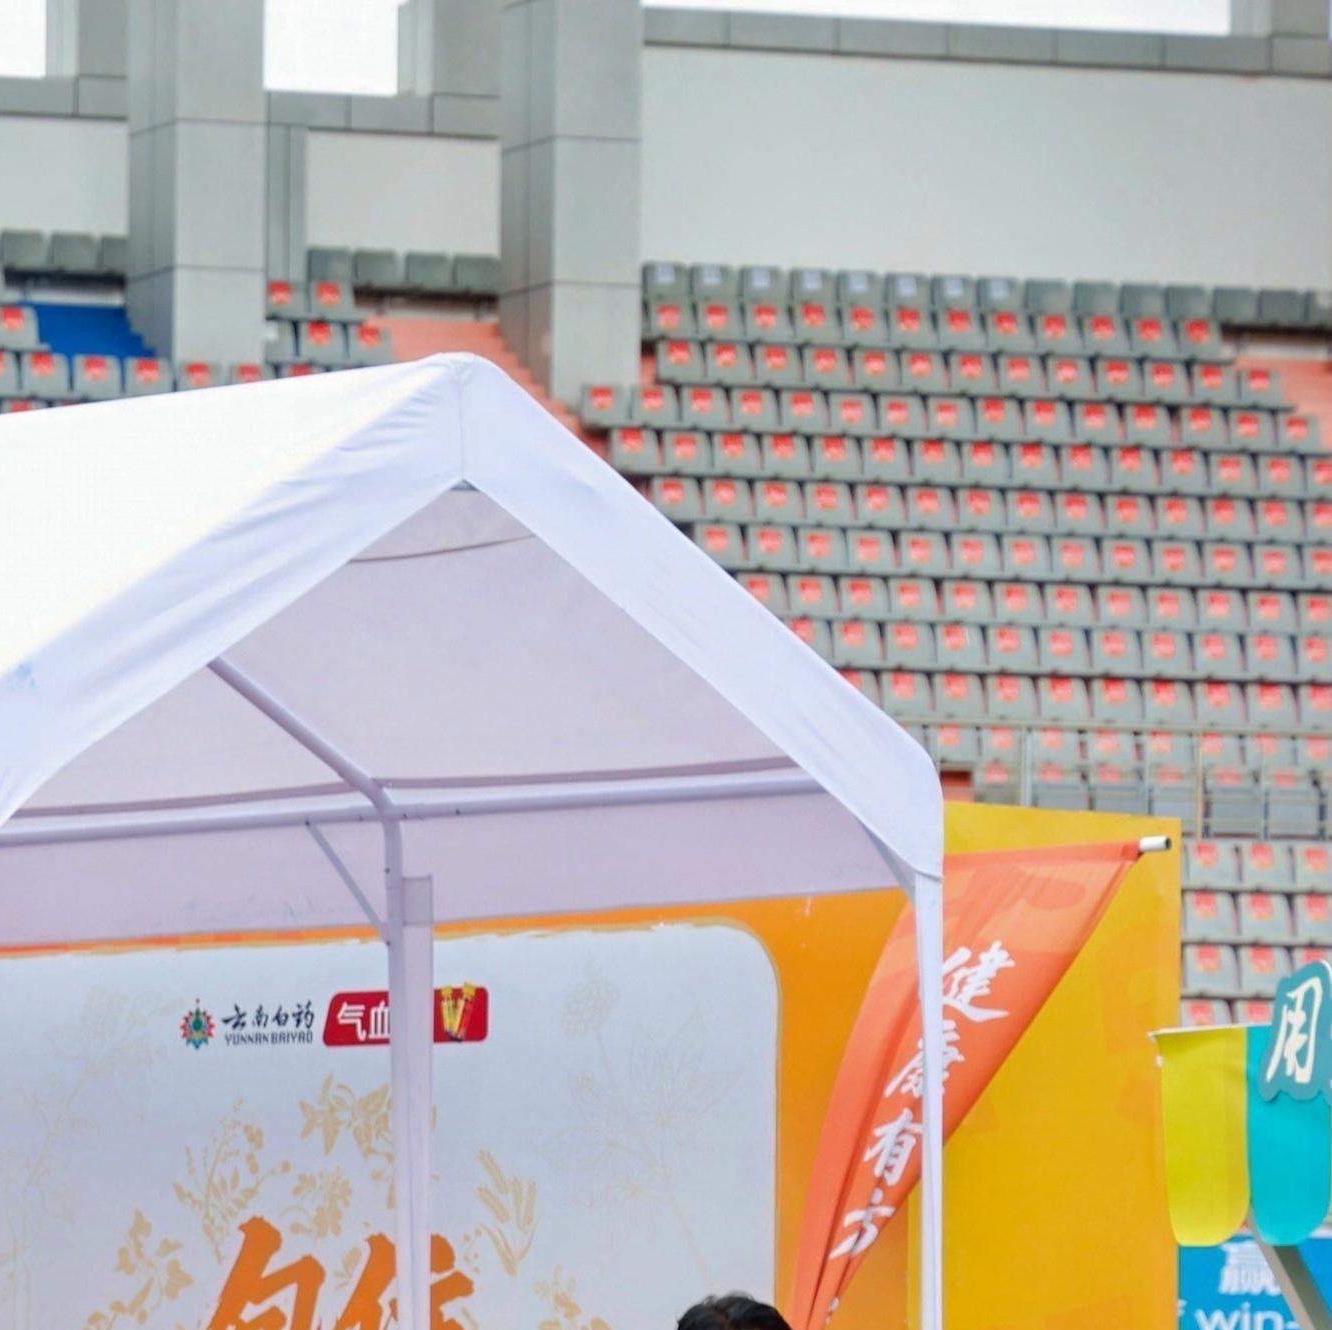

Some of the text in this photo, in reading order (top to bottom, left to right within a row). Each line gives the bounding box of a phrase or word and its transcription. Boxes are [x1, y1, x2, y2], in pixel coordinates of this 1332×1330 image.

[222, 999, 315, 1030] 云南白药
[224, 1030, 314, 1046] YUNNAN BAIYAO
